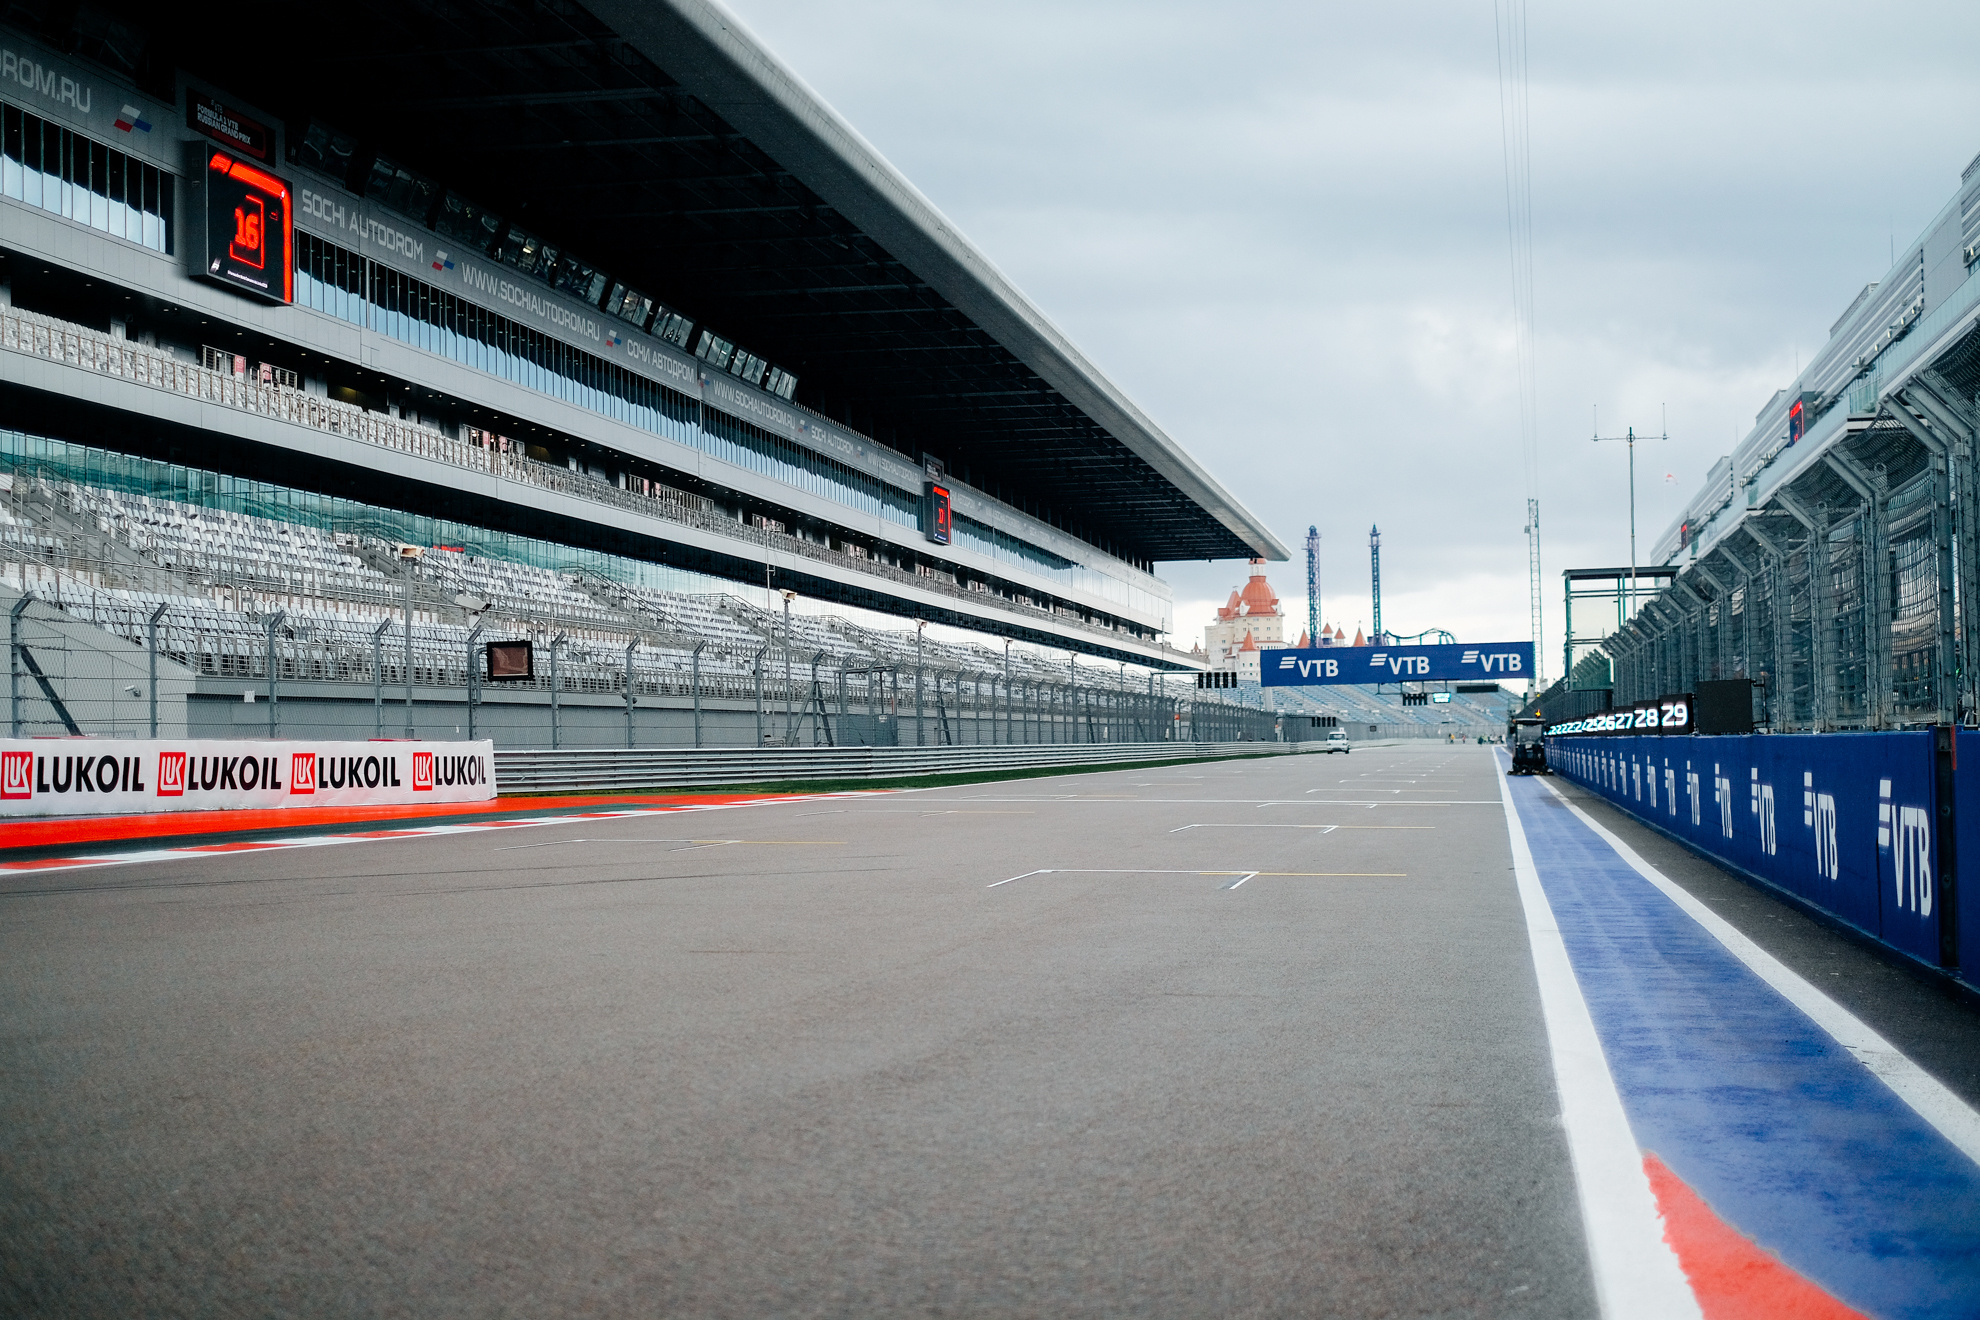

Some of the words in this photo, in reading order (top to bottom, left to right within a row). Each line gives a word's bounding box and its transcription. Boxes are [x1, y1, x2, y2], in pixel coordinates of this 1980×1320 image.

[0, 49, 91, 113] ROM.RU
[197, 103, 223, 124] FORMULA
[227, 118, 239, 130] VTB
[197, 112, 221, 131] RUSSIAN
[220, 124, 239, 140] GRAND
[238, 132, 251, 145] PRIX
[233, 207, 259, 250] 16
[302, 189, 345, 229] SOCHI
[349, 212, 424, 263] AUTODROM
[461, 261, 600, 342] WWW.SOCHIAUTODROM.RU
[627, 338, 651, 365] СОЧИ
[651, 350, 695, 384] АВТОДРОМ
[713, 379, 796, 430] WWW.SOCHIAUTODROM.RU
[1297, 659, 1339, 678] VTB
[1388, 656, 1430, 675] VTB
[1480, 653, 1523, 673] VTB
[1597, 715, 1616, 731] 26
[1615, 712, 1634, 730] 27
[1634, 708, 1659, 728] 28
[1661, 704, 1688, 726] 29
[37, 755, 145, 793] LUKOIL
[188, 755, 282, 791] LUKOIL
[318, 755, 401, 789] LUKOIL
[435, 754, 487, 785] LUKOIL
[1719, 777, 1733, 839] VTB
[1757, 784, 1777, 856] VTB
[1812, 792, 1839, 881] VTB
[1891, 804, 1932, 917] VTB
